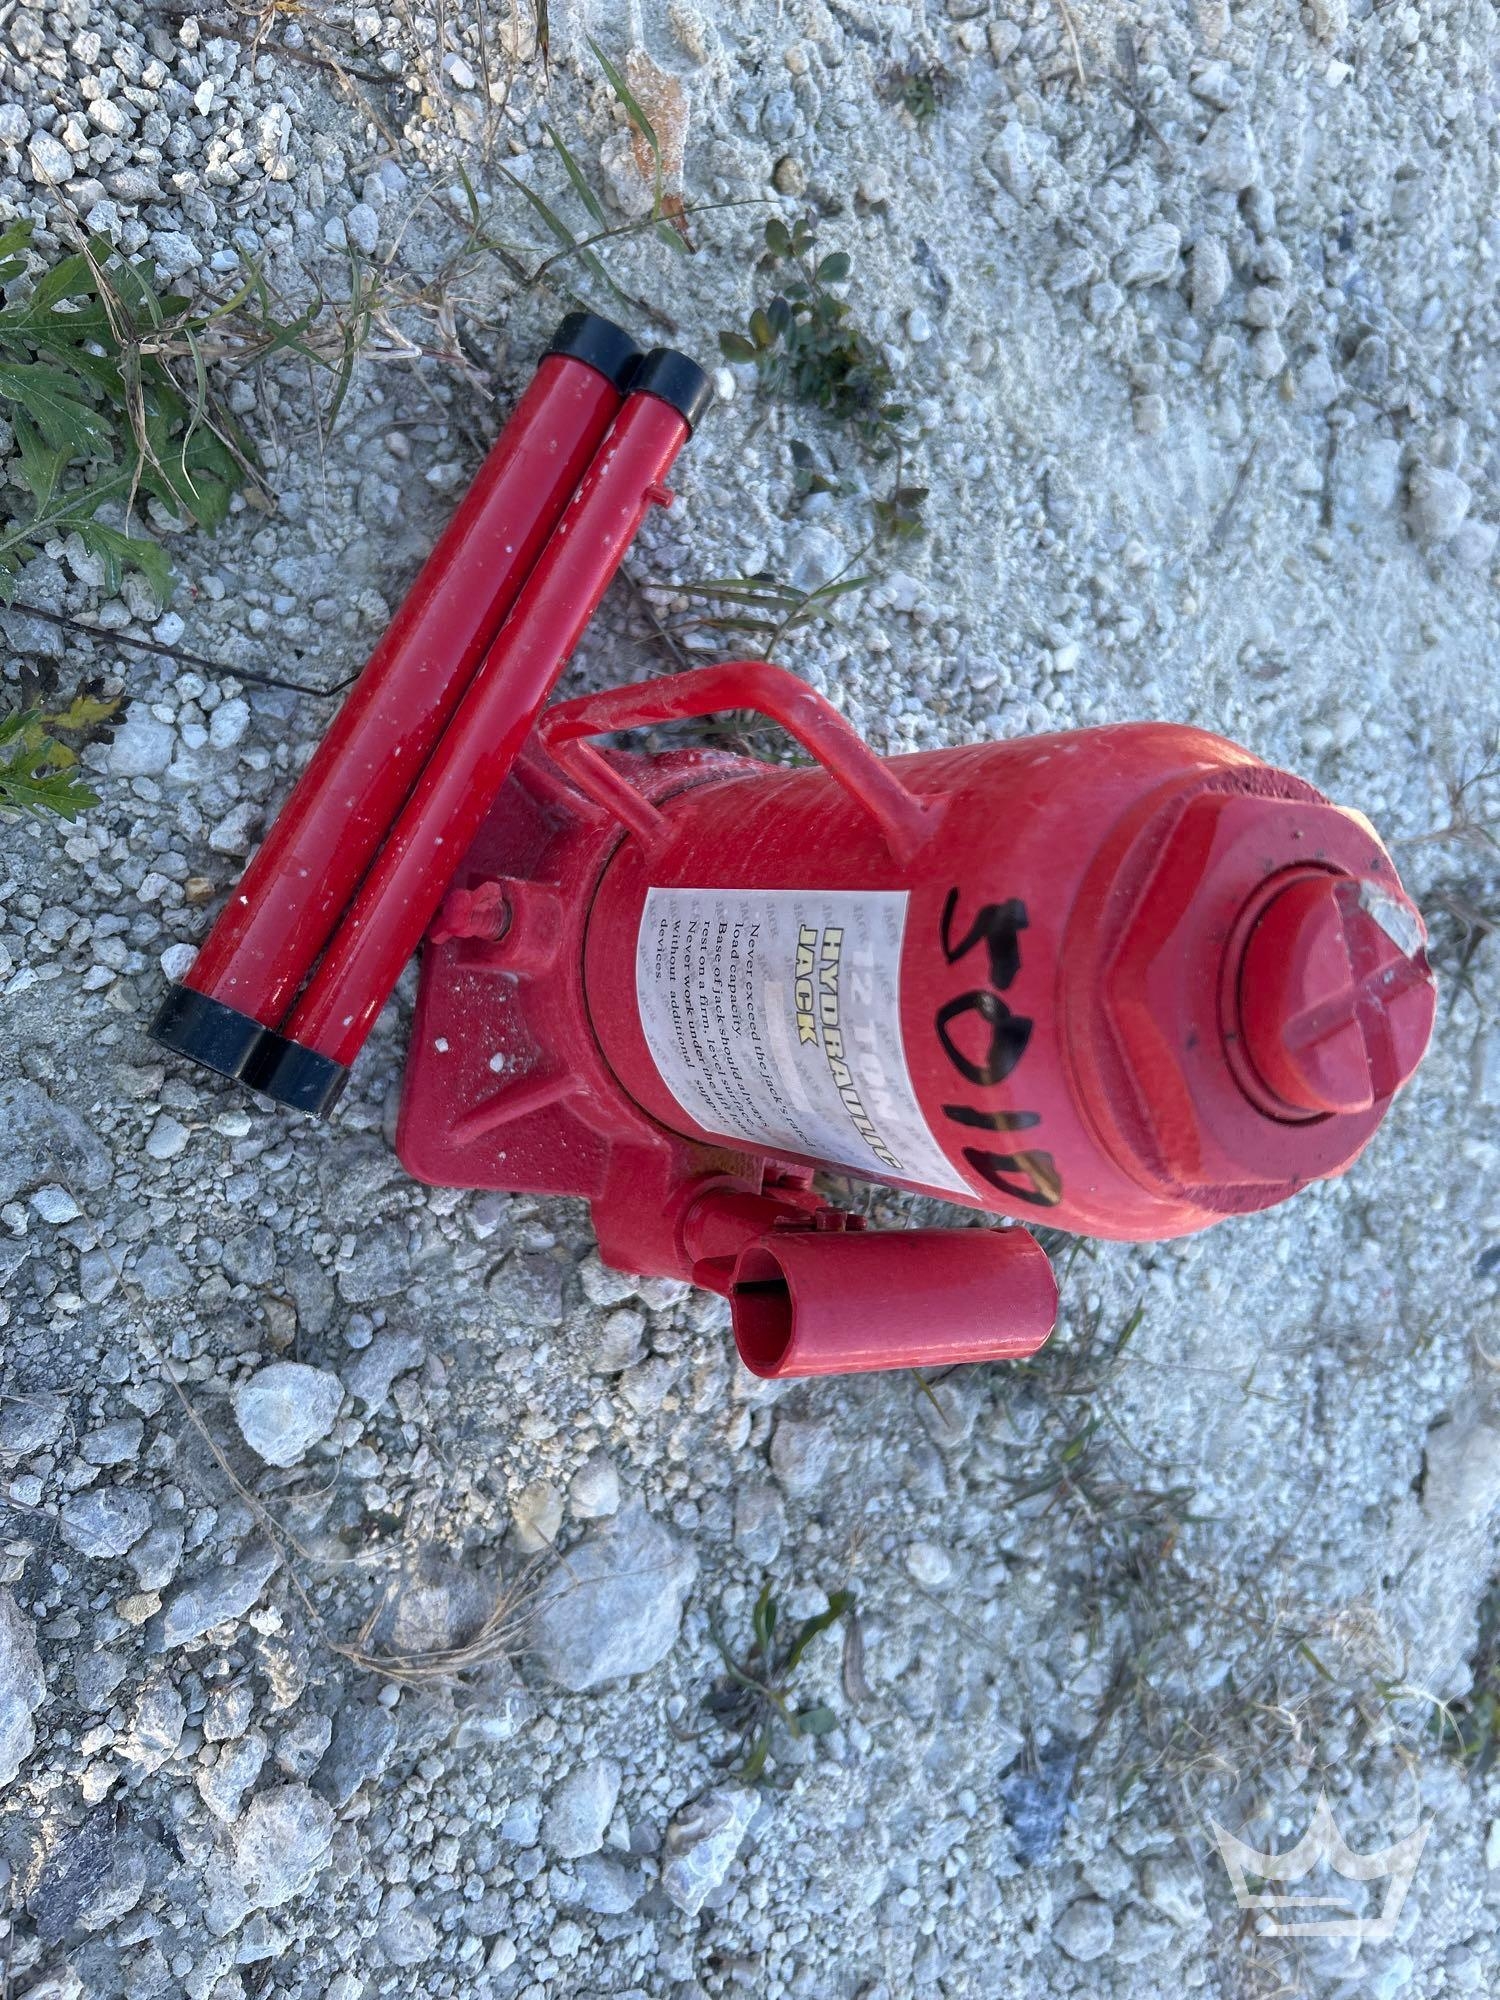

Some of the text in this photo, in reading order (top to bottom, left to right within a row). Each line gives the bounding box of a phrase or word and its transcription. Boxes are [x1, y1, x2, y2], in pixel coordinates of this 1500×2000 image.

[655, 919, 668, 983] devices.
[669, 920, 681, 981] without
[684, 921, 698, 970] Never
[700, 921, 710, 951] rest
[714, 921, 728, 962] Base
[745, 923, 760, 977] Never
[698, 956, 706, 976] on
[713, 967, 723, 987] of
[728, 922, 744, 1039] load capacity.
[795, 924, 819, 1047] JACK
[851, 941, 874, 1006] 12
[684, 975, 694, 1015] work
[712, 986, 726, 1024] jack
[745, 980, 761, 1041] exceed
[670, 990, 696, 1068] additional
[688, 1020, 705, 1063] under
[819, 927, 904, 1170] HYDRAULIC
[707, 1039, 726, 1076] level
[719, 1028, 742, 1080] should
[755, 1047, 767, 1070] the
[853, 1019, 900, 1121] TON
[702, 1065, 716, 1089] the
[760, 1070, 788, 1115] jack's
[694, 1079, 730, 1124] support
[714, 1090, 732, 1111] lift
[737, 1082, 770, 1128] always
[729, 1113, 756, 1136] load
[786, 1116, 816, 1147] rated
